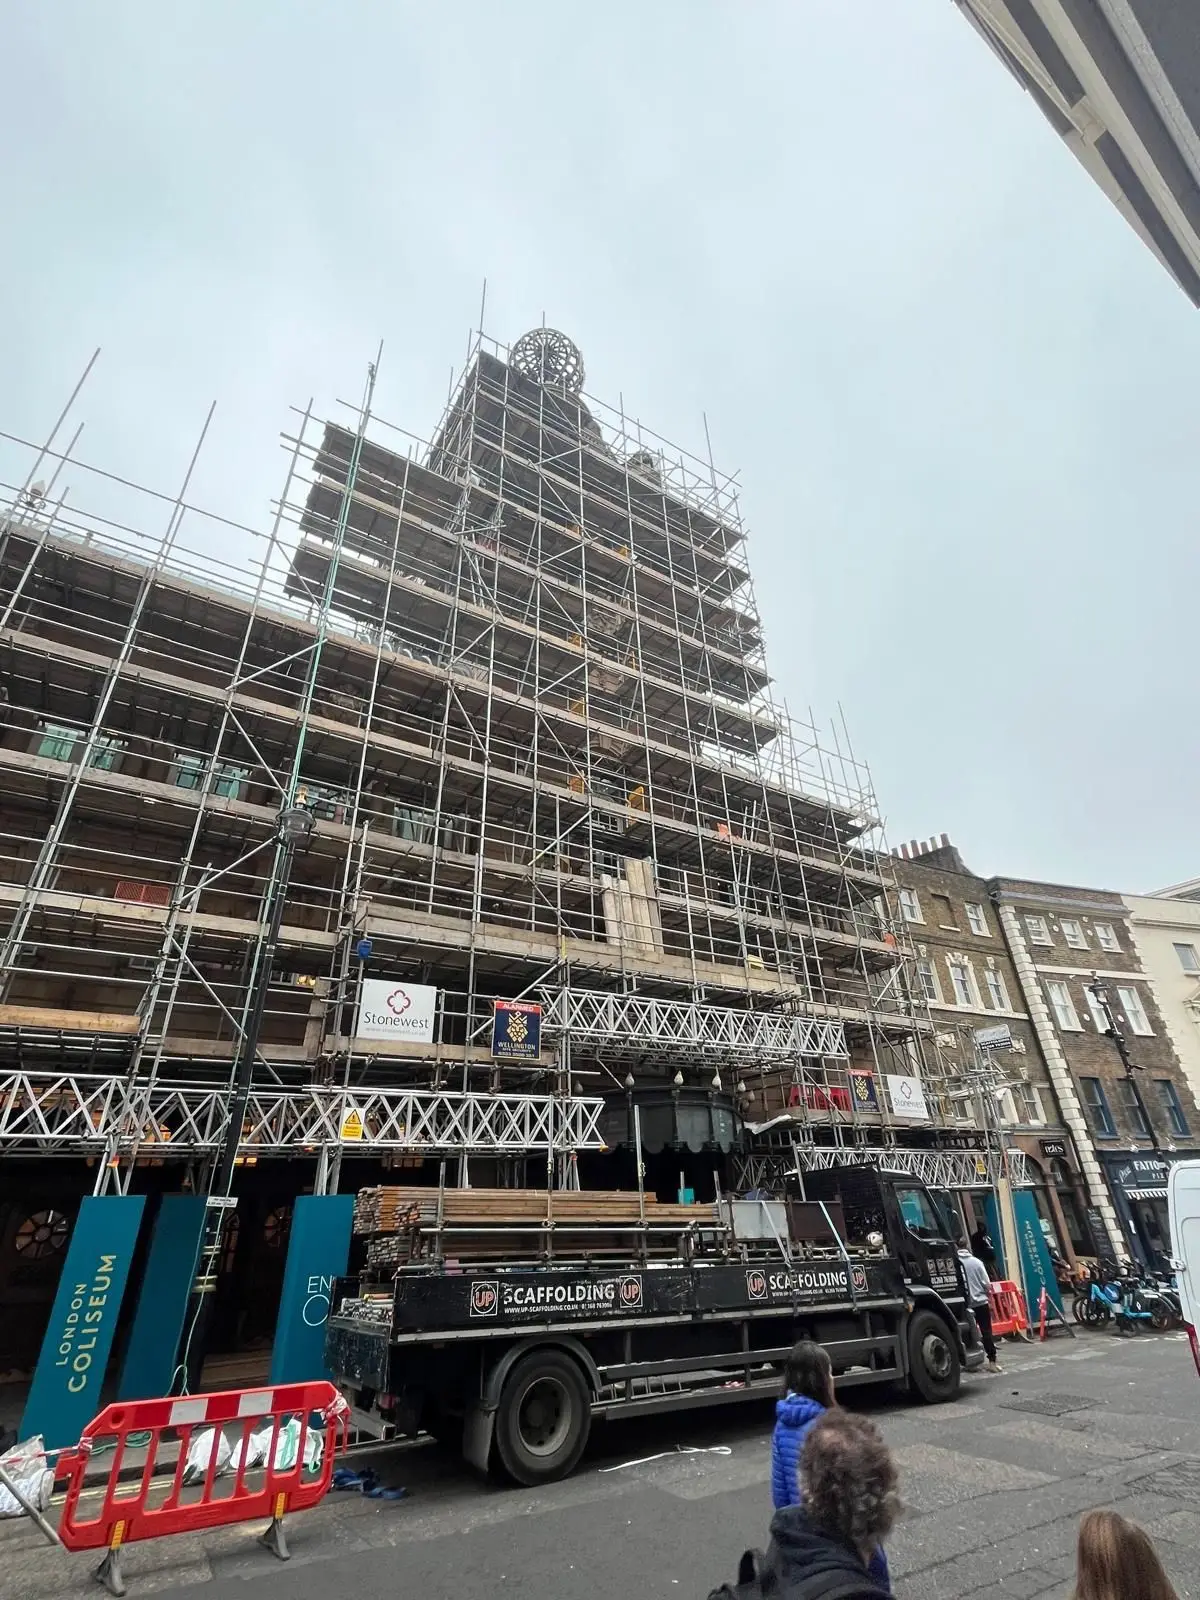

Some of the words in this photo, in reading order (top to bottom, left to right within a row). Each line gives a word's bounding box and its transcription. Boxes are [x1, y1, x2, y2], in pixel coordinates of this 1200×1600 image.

[502, 1003, 534, 1012] ALARMED
[364, 1011, 429, 1029] Stonewest
[497, 1041, 536, 1050] WELLINGTON
[1133, 1159, 1160, 1170] FATTO
[750, 1277, 764, 1292] UP
[852, 1272, 864, 1285] UP
[475, 1290, 495, 1308] UP
[503, 1284, 615, 1305] SCAFFOLDING
[622, 1285, 640, 1300] UP
[56, 1284, 87, 1366] LONDON
[68, 1255, 117, 1393] COLISEUM
